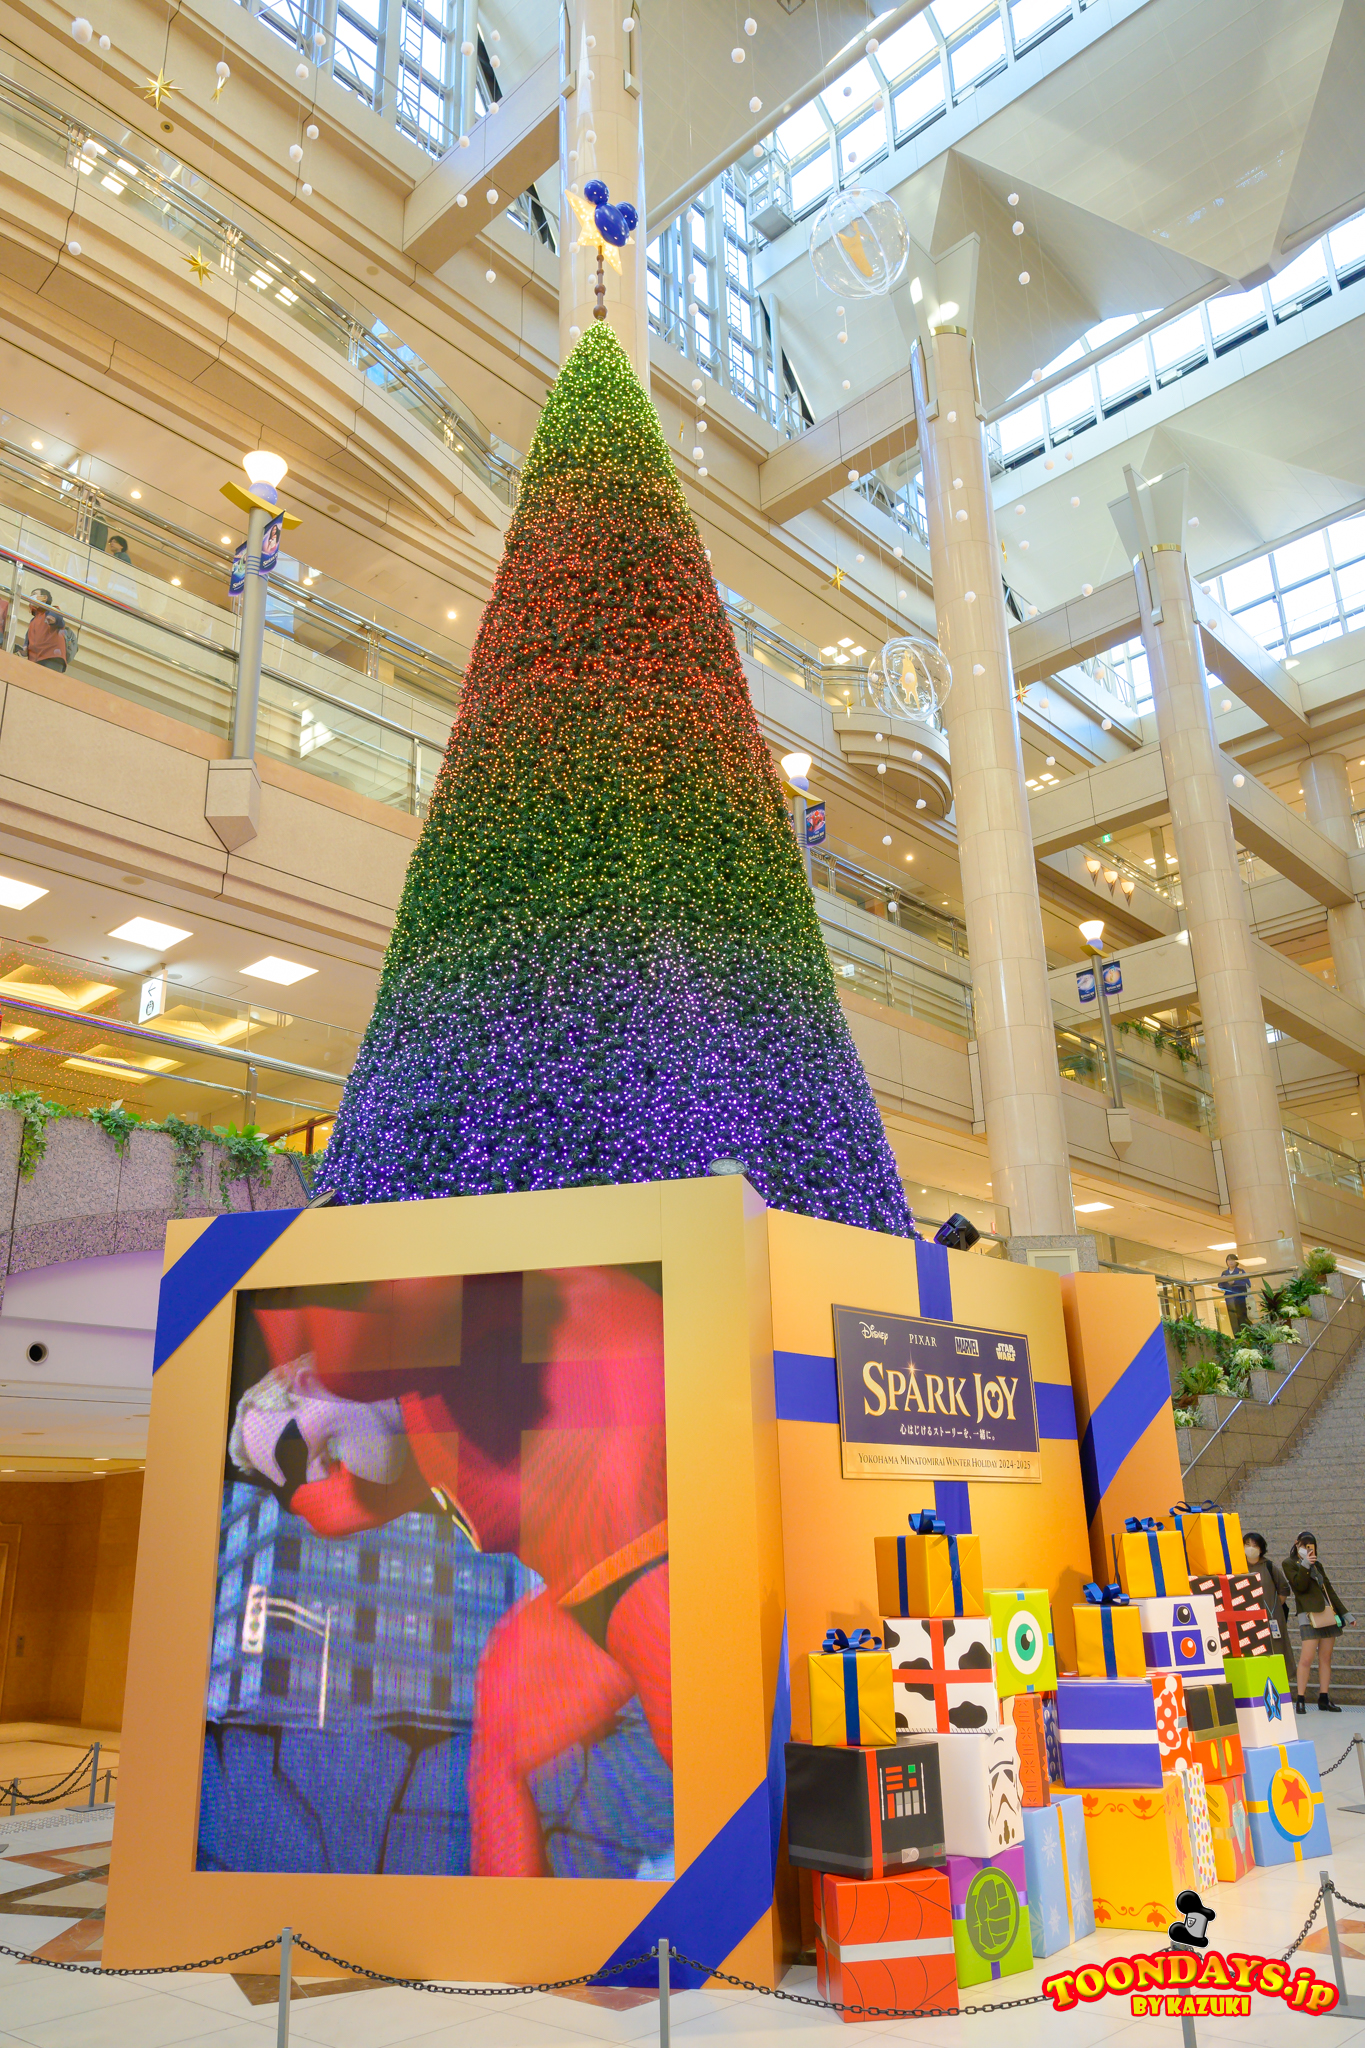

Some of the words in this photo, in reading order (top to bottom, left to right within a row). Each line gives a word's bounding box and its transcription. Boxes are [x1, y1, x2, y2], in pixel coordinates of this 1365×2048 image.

[908, 1333, 937, 1348] PIXAR
[954, 1336, 979, 1357] MARVEL
[996, 1342, 1016, 1353] STAR
[996, 1351, 1016, 1362] WARS
[862, 1360, 971, 1417] SPARK
[973, 1372, 1019, 1424] JOY
[858, 1452, 899, 1465] YOKOHAMA
[900, 1454, 945, 1467] MINATOMIRAI
[945, 1456, 971, 1468] WINTER
[971, 1457, 998, 1469] HOLIDAY
[998, 1459, 1031, 1470] 2024-2025
